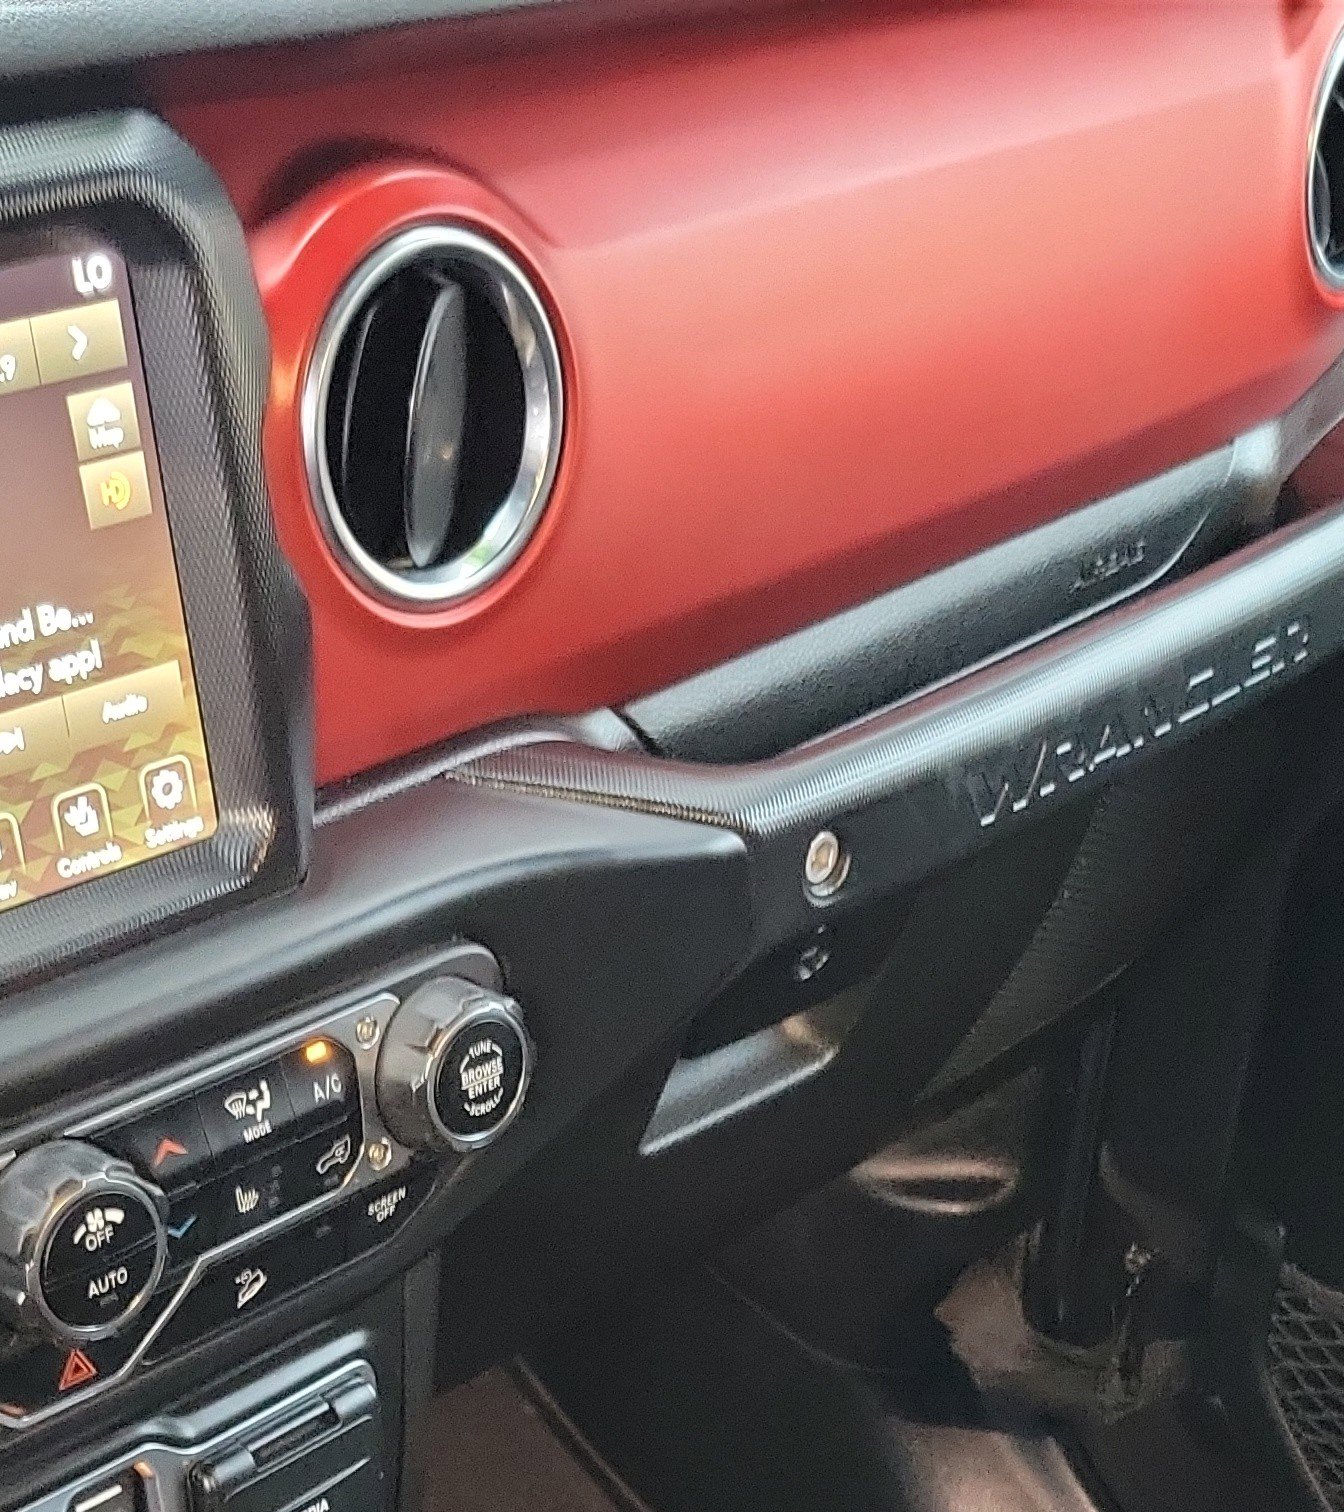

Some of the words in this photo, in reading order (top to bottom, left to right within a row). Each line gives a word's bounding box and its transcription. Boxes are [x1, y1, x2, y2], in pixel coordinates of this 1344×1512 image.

[71, 254, 112, 295] LO
[469, 1038, 493, 1058] TUNE
[461, 1056, 503, 1088] BROWSE
[313, 1074, 342, 1103] A/C
[468, 1075, 501, 1099] ENTER
[243, 1120, 271, 1143] MODE
[367, 1186, 407, 1217] SCREEN
[375, 1203, 396, 1223] OFF
[84, 1228, 115, 1252] OFF
[88, 1267, 129, 1299] AUTO
